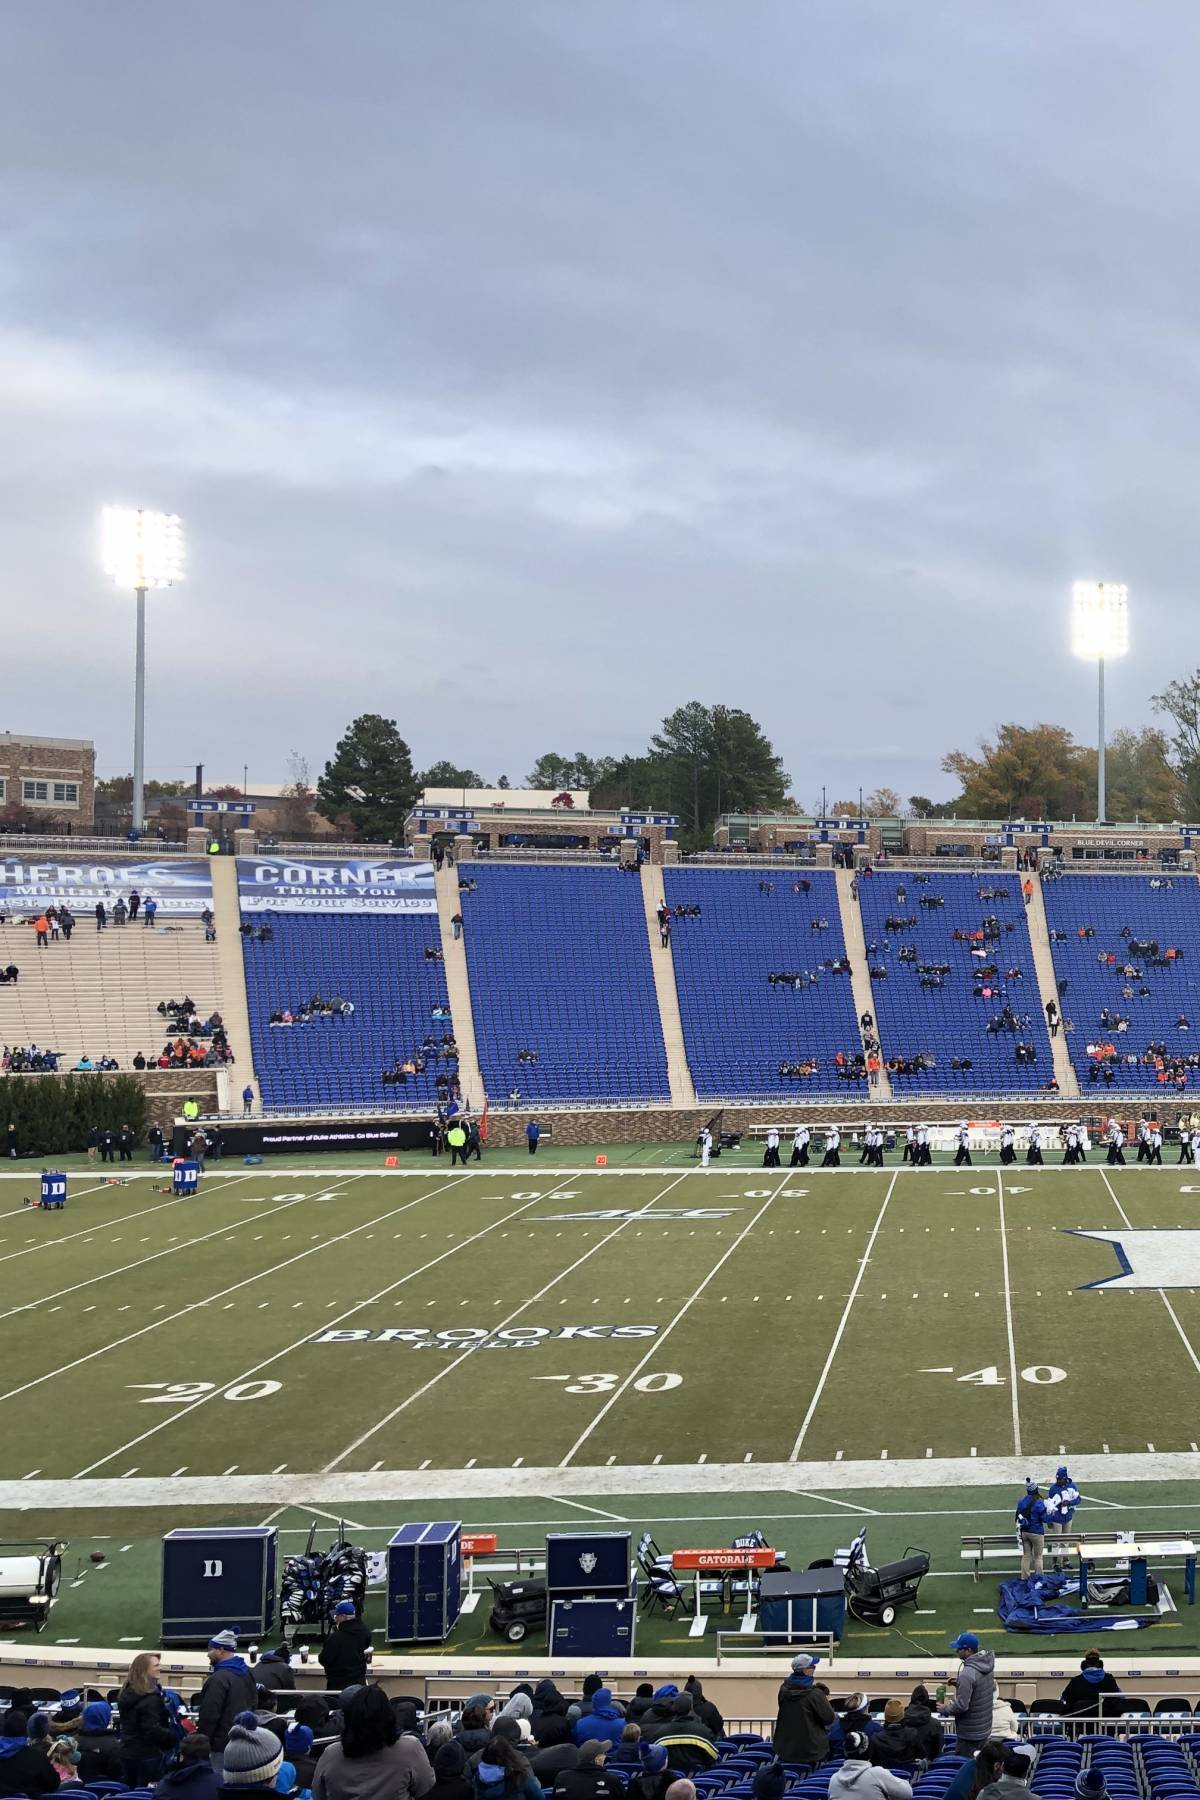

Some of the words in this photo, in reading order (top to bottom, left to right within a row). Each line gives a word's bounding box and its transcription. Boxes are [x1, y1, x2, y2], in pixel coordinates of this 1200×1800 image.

[0, 864, 175, 886] HEROES
[255, 866, 417, 887] CORNER
[16, 886, 124, 897] Military
[141, 887, 161, 897] &
[274, 886, 348, 896] Thank
[354, 886, 397, 896] You
[248, 897, 289, 907] For
[295, 897, 347, 908] Your
[352, 898, 432, 909] Service
[184, 1170, 197, 1181] D
[51, 1182, 65, 1195] D
[307, 1325, 661, 1342] BROOKS
[411, 1341, 541, 1350] FIELD
[564, 1373, 684, 1394] 30
[957, 1366, 1068, 1386] 40
[138, 1380, 283, 1403] 20
[735, 1538, 756, 1548] DUKE
[203, 1560, 223, 1577] D
